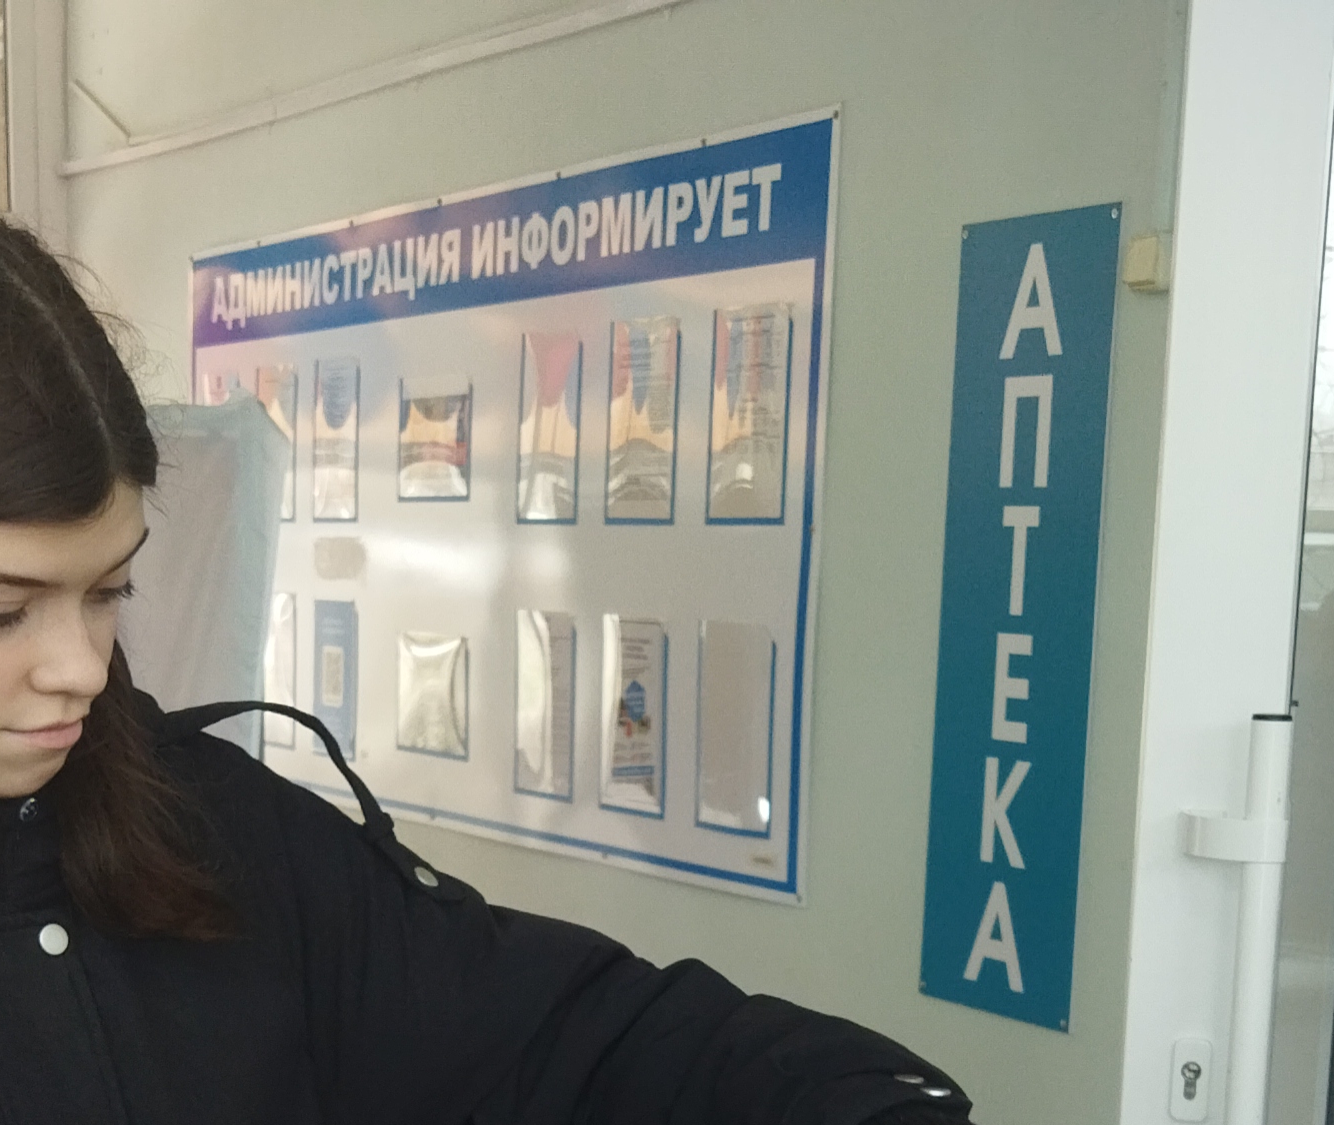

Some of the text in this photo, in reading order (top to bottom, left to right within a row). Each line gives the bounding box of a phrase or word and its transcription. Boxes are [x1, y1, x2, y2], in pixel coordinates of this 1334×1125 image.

[211, 163, 782, 330] АДМИНИСТРАЦИЯ ИНФОРМИРУЕТ
[963, 243, 1063, 994] АПТЕКА
